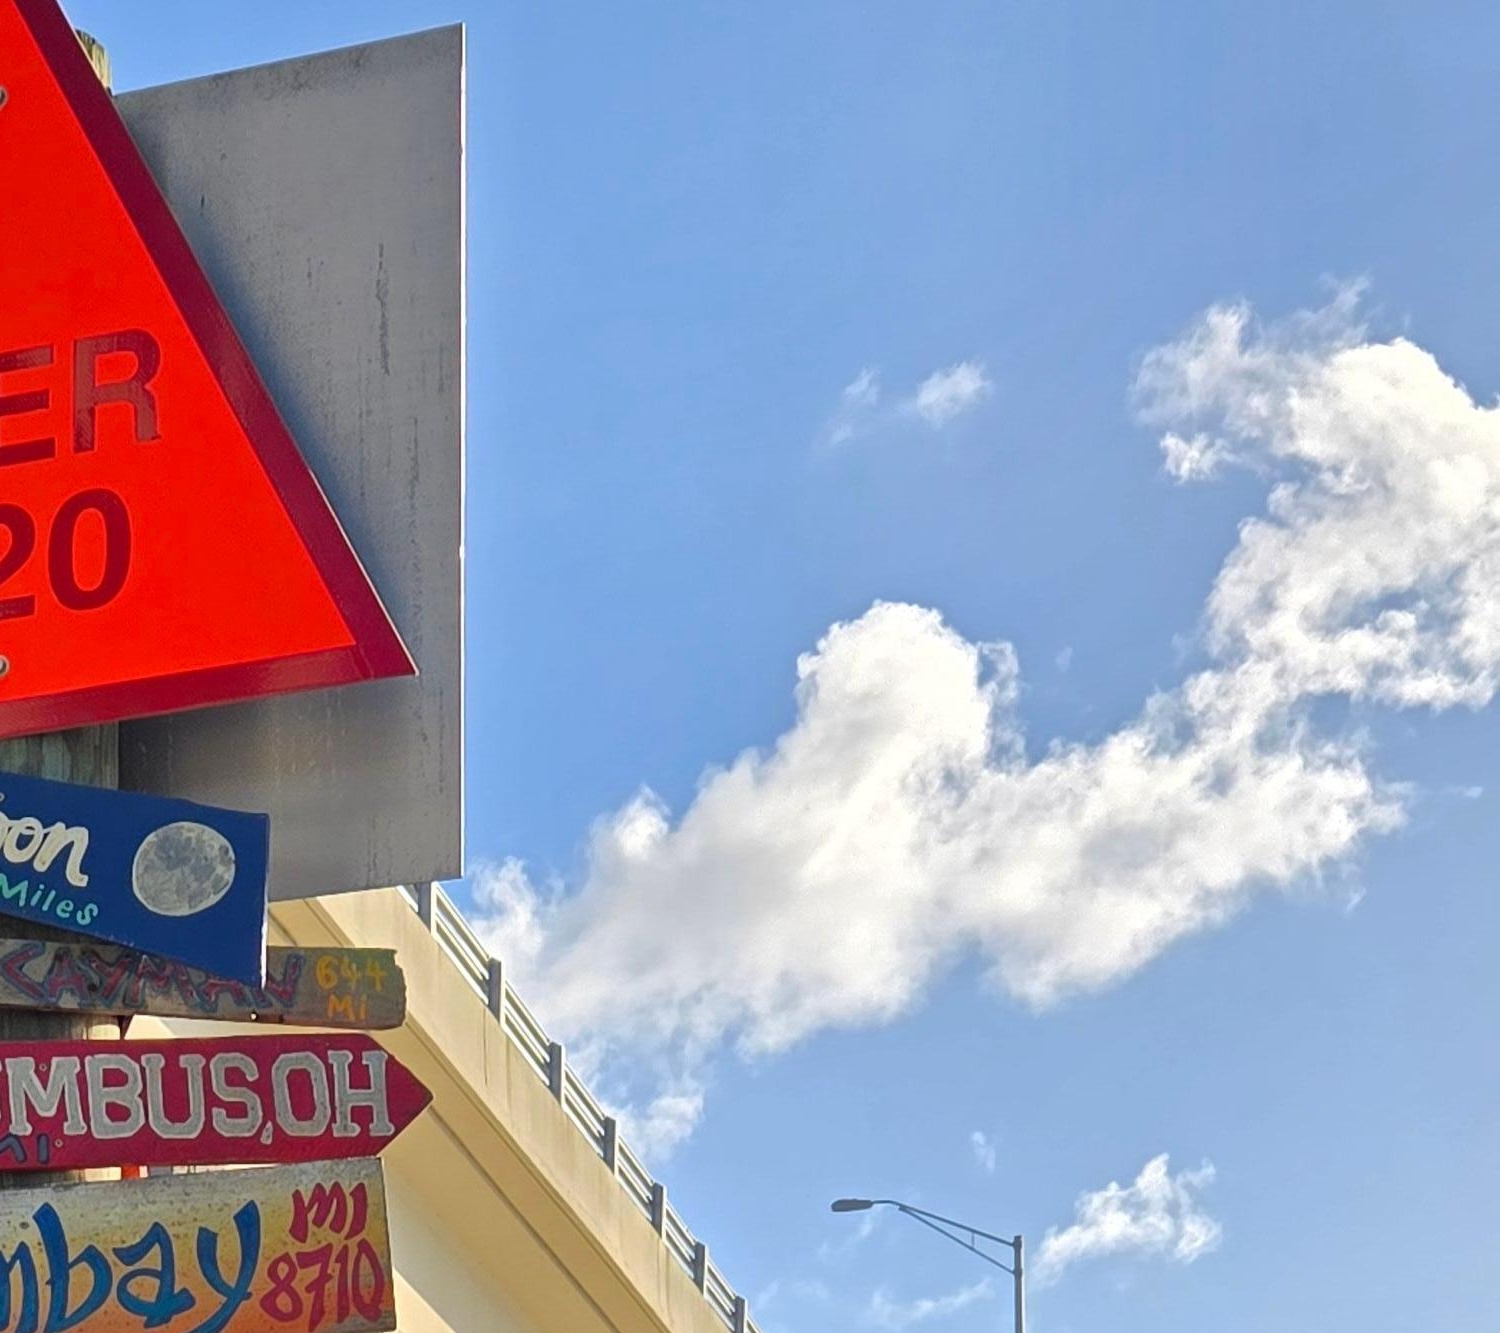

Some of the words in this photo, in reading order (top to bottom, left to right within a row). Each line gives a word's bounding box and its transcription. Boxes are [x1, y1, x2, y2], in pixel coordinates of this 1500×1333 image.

[315, 955, 389, 992] 644
[326, 991, 368, 1022] MI
[259, 1238, 385, 1330] 8710
